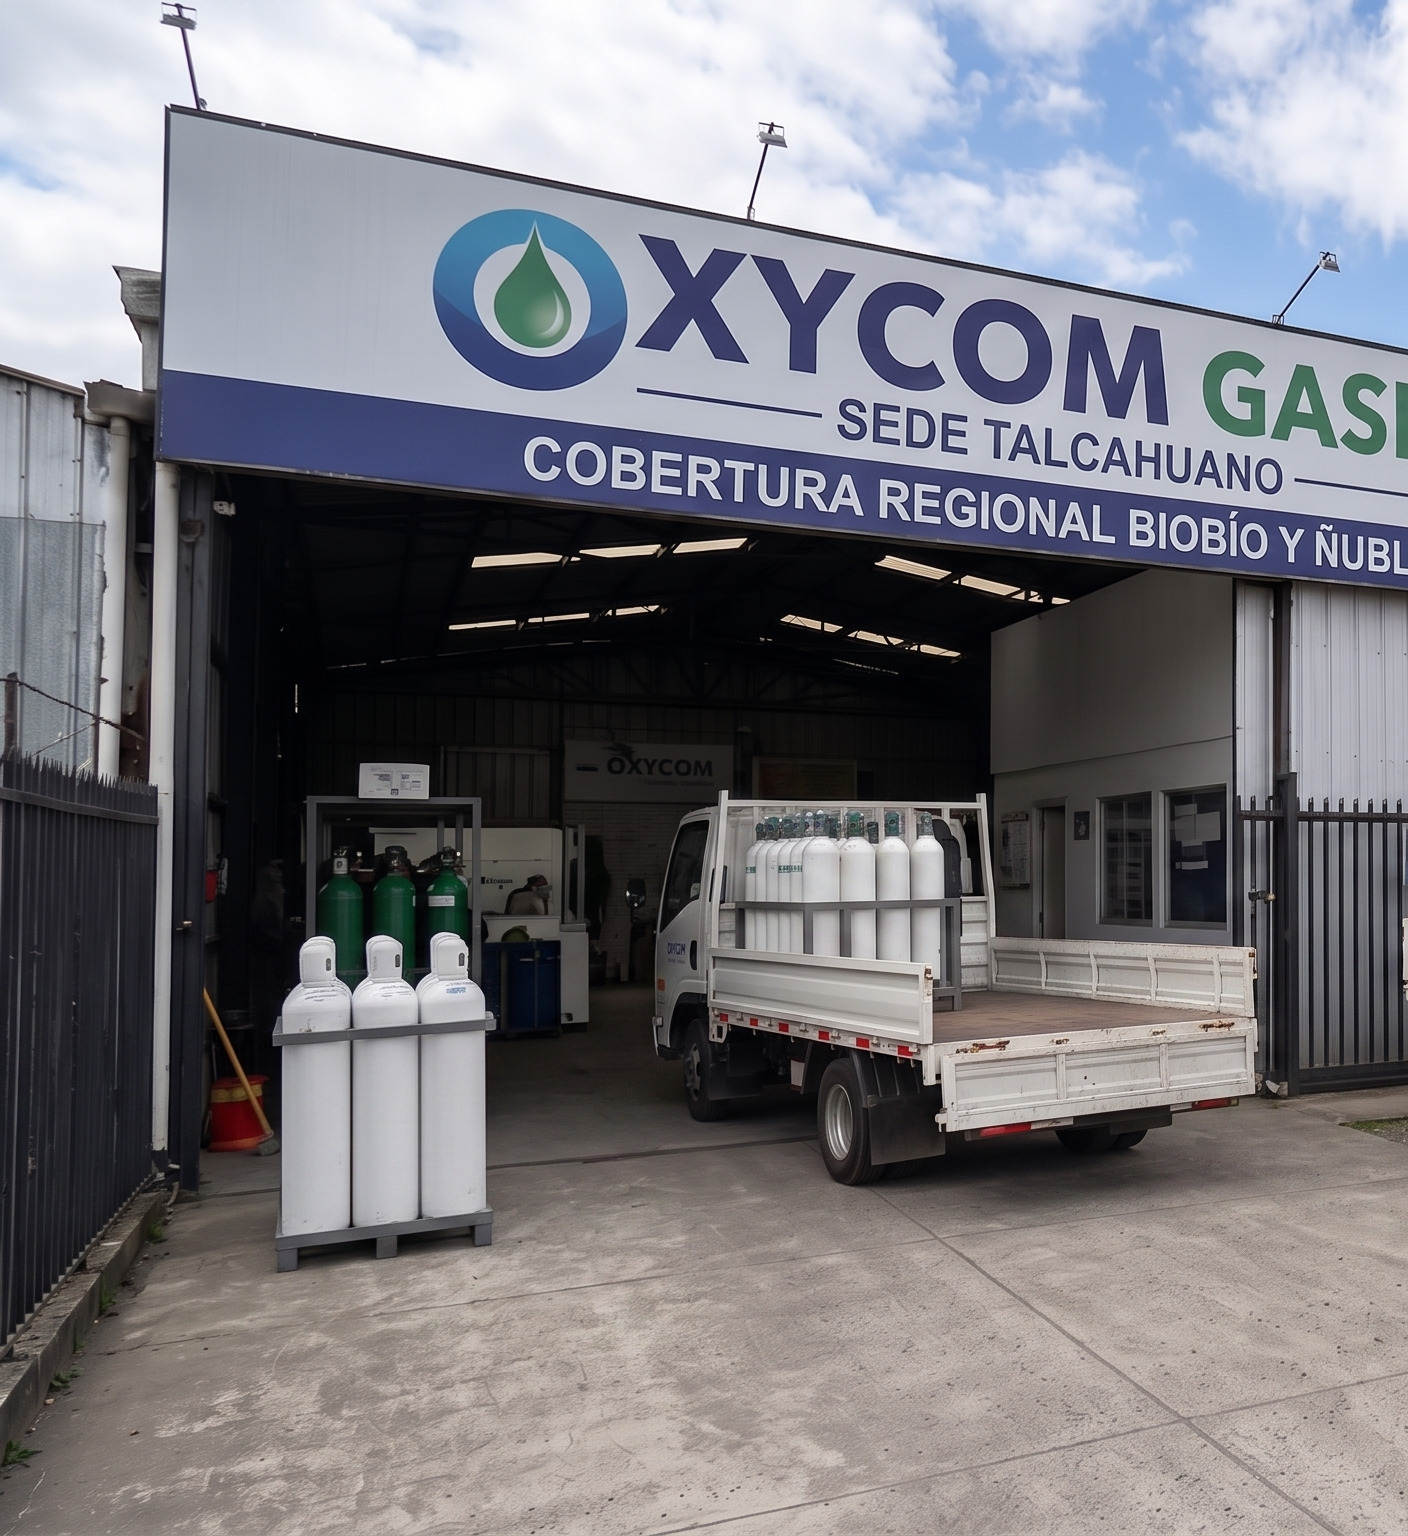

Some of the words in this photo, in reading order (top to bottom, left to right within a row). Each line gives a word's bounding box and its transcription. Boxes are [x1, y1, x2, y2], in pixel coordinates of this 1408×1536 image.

[837, 398, 969, 456] SEDE
[984, 417, 1284, 495] TALCAHUANO
[523, 436, 864, 517] COBERTURA
[877, 479, 1116, 546] REGIONAL
[1129, 509, 1269, 562] BIOBÍO
[1279, 528, 1305, 564] Y
[606, 757, 713, 777] OXYCOM
